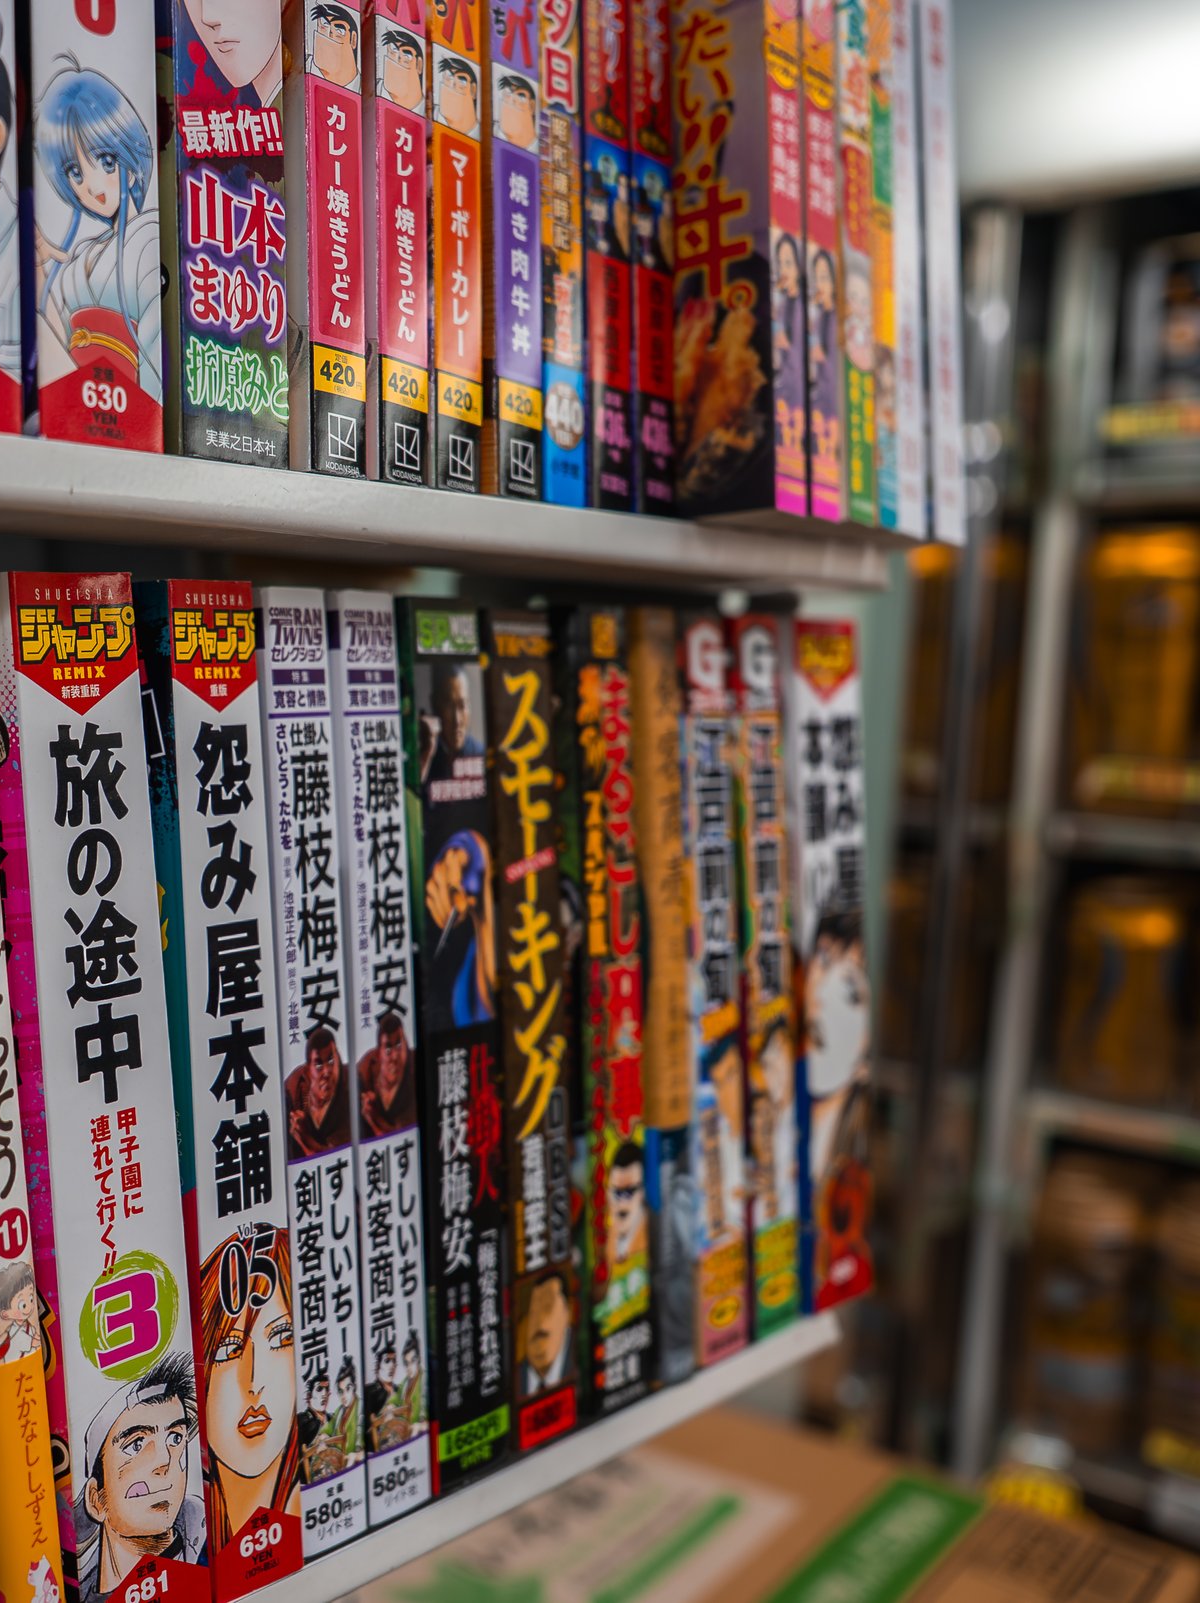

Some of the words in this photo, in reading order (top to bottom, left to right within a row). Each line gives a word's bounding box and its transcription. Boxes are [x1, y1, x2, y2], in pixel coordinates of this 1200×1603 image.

[186, 171, 286, 266] 山本
[326, 104, 352, 329] カレー焼きうどん
[394, 127, 417, 343] カレー焼きうどん
[449, 149, 470, 357] マーボーカレー
[508, 171, 531, 358] 焼き肉牛丼
[188, 256, 286, 341] まゆり
[320, 360, 355, 388] 420
[388, 372, 419, 400] 420
[82, 379, 128, 413] 630
[443, 387, 472, 411] 420
[505, 394, 534, 416] 420
[205, 428, 277, 458] 実業之日本社
[325, 461, 360, 476] KODANSHA
[392, 469, 423, 484] KODANSHA
[34, 588, 114, 601] SHUEISHA
[185, 593, 244, 606] SHUEISHA
[268, 607, 293, 618] COMIC
[293, 607, 322, 626] RAN
[268, 619, 323, 646] TWINS
[17, 604, 136, 664] ジャンプ
[173, 607, 256, 663] ジャンプ
[271, 648, 324, 662] セレクション
[53, 665, 106, 681] REMIX
[194, 666, 242, 679] REMIX
[61, 684, 101, 699] 新装重版
[209, 683, 228, 697] 重版
[290, 722, 328, 747] 仕掛人
[291, 749, 341, 1040] 藤枝梅安
[364, 747, 408, 1023] 藤枝梅安
[49, 721, 143, 1104] 旅の途中
[500, 670, 568, 1141] スモーキング
[193, 721, 274, 1219] 怨み屋本舗
[116, 1106, 144, 1218] 甲子園に
[437, 1048, 472, 1276] 藤枝梅安
[365, 1145, 397, 1353] 剣客商売
[218, 1230, 278, 1318] 05
[293, 1165, 330, 1382] 剣客商売
[92, 1271, 161, 1370] 3
[15, 1371, 48, 1550] たかなししずえ
[251, 1513, 270, 1528] 定価
[317, 1516, 354, 1541] リイド社
[239, 1523, 283, 1557] 630
[251, 1548, 273, 1564] YEN
[125, 1570, 169, 1603] 681
